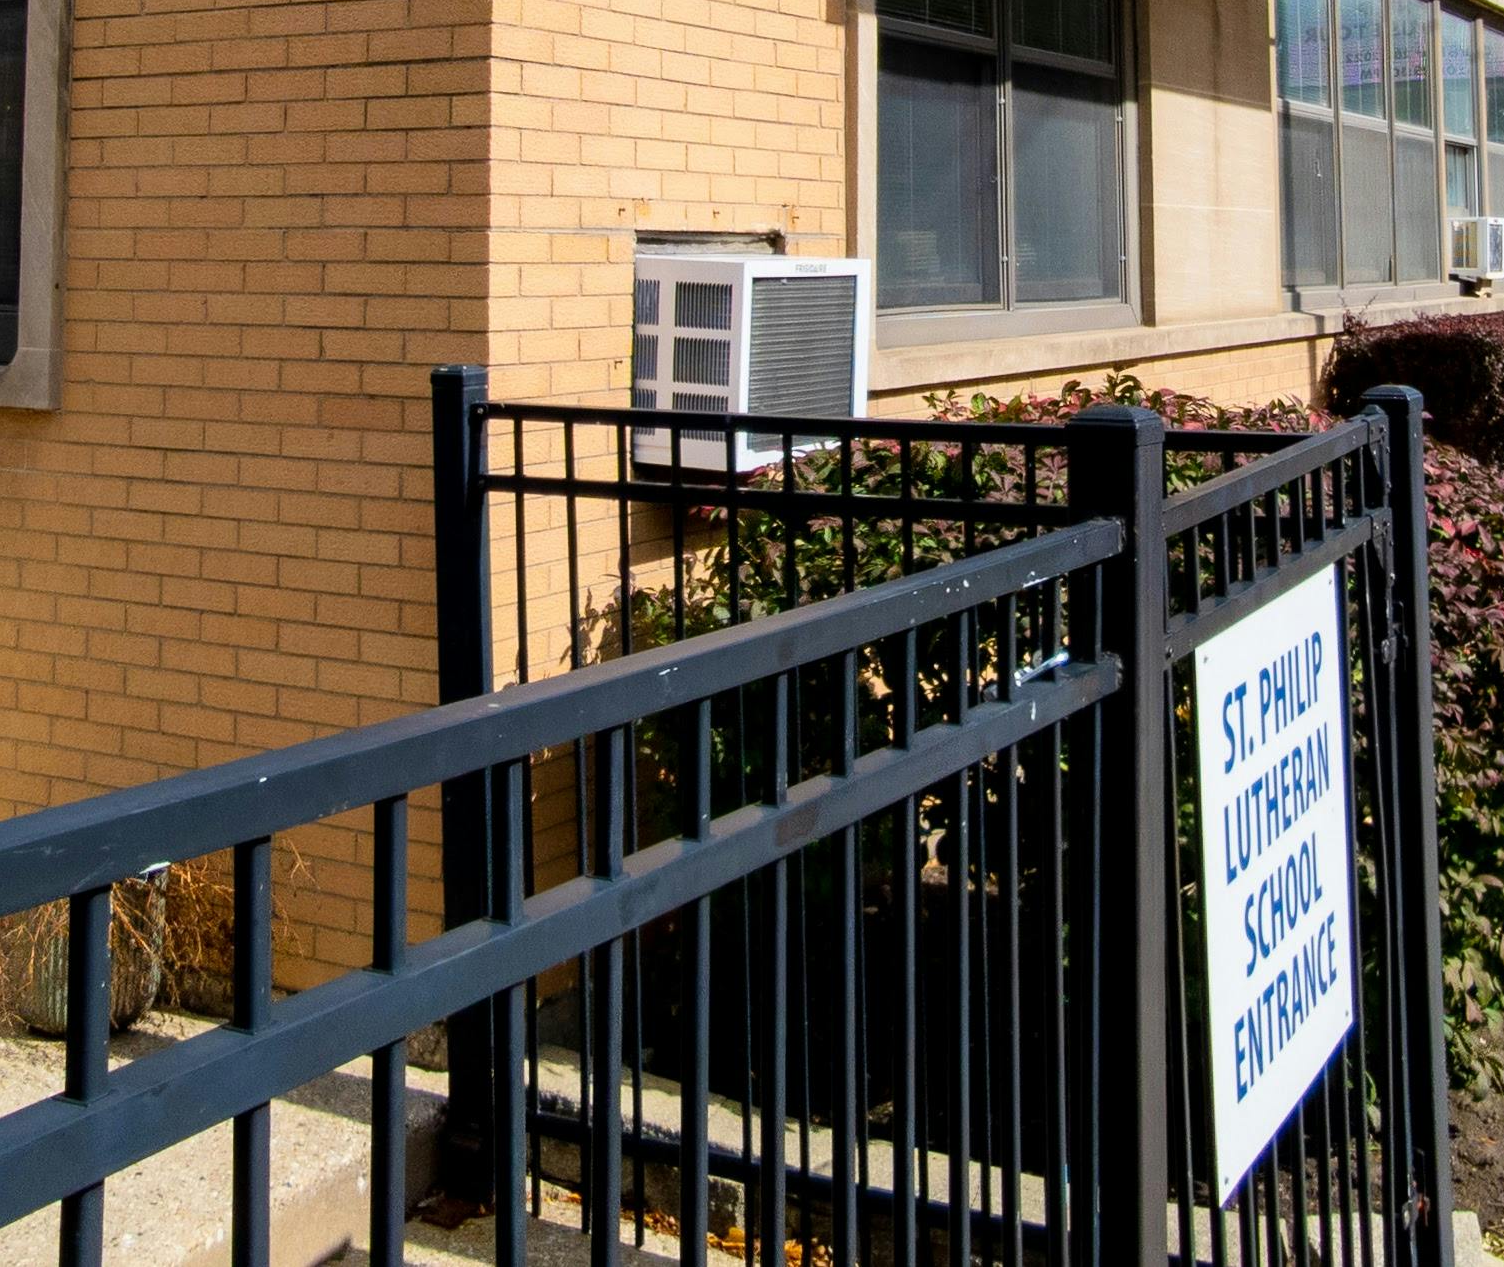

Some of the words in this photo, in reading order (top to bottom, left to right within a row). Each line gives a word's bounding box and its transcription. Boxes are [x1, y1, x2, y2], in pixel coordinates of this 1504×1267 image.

[1222, 680, 1254, 775] ST.
[1259, 630, 1323, 733] PHILIP
[1224, 721, 1331, 886] LUTHERAN
[1244, 831, 1323, 978] SCHOOL
[1233, 911, 1338, 1104] ENTRANCE
